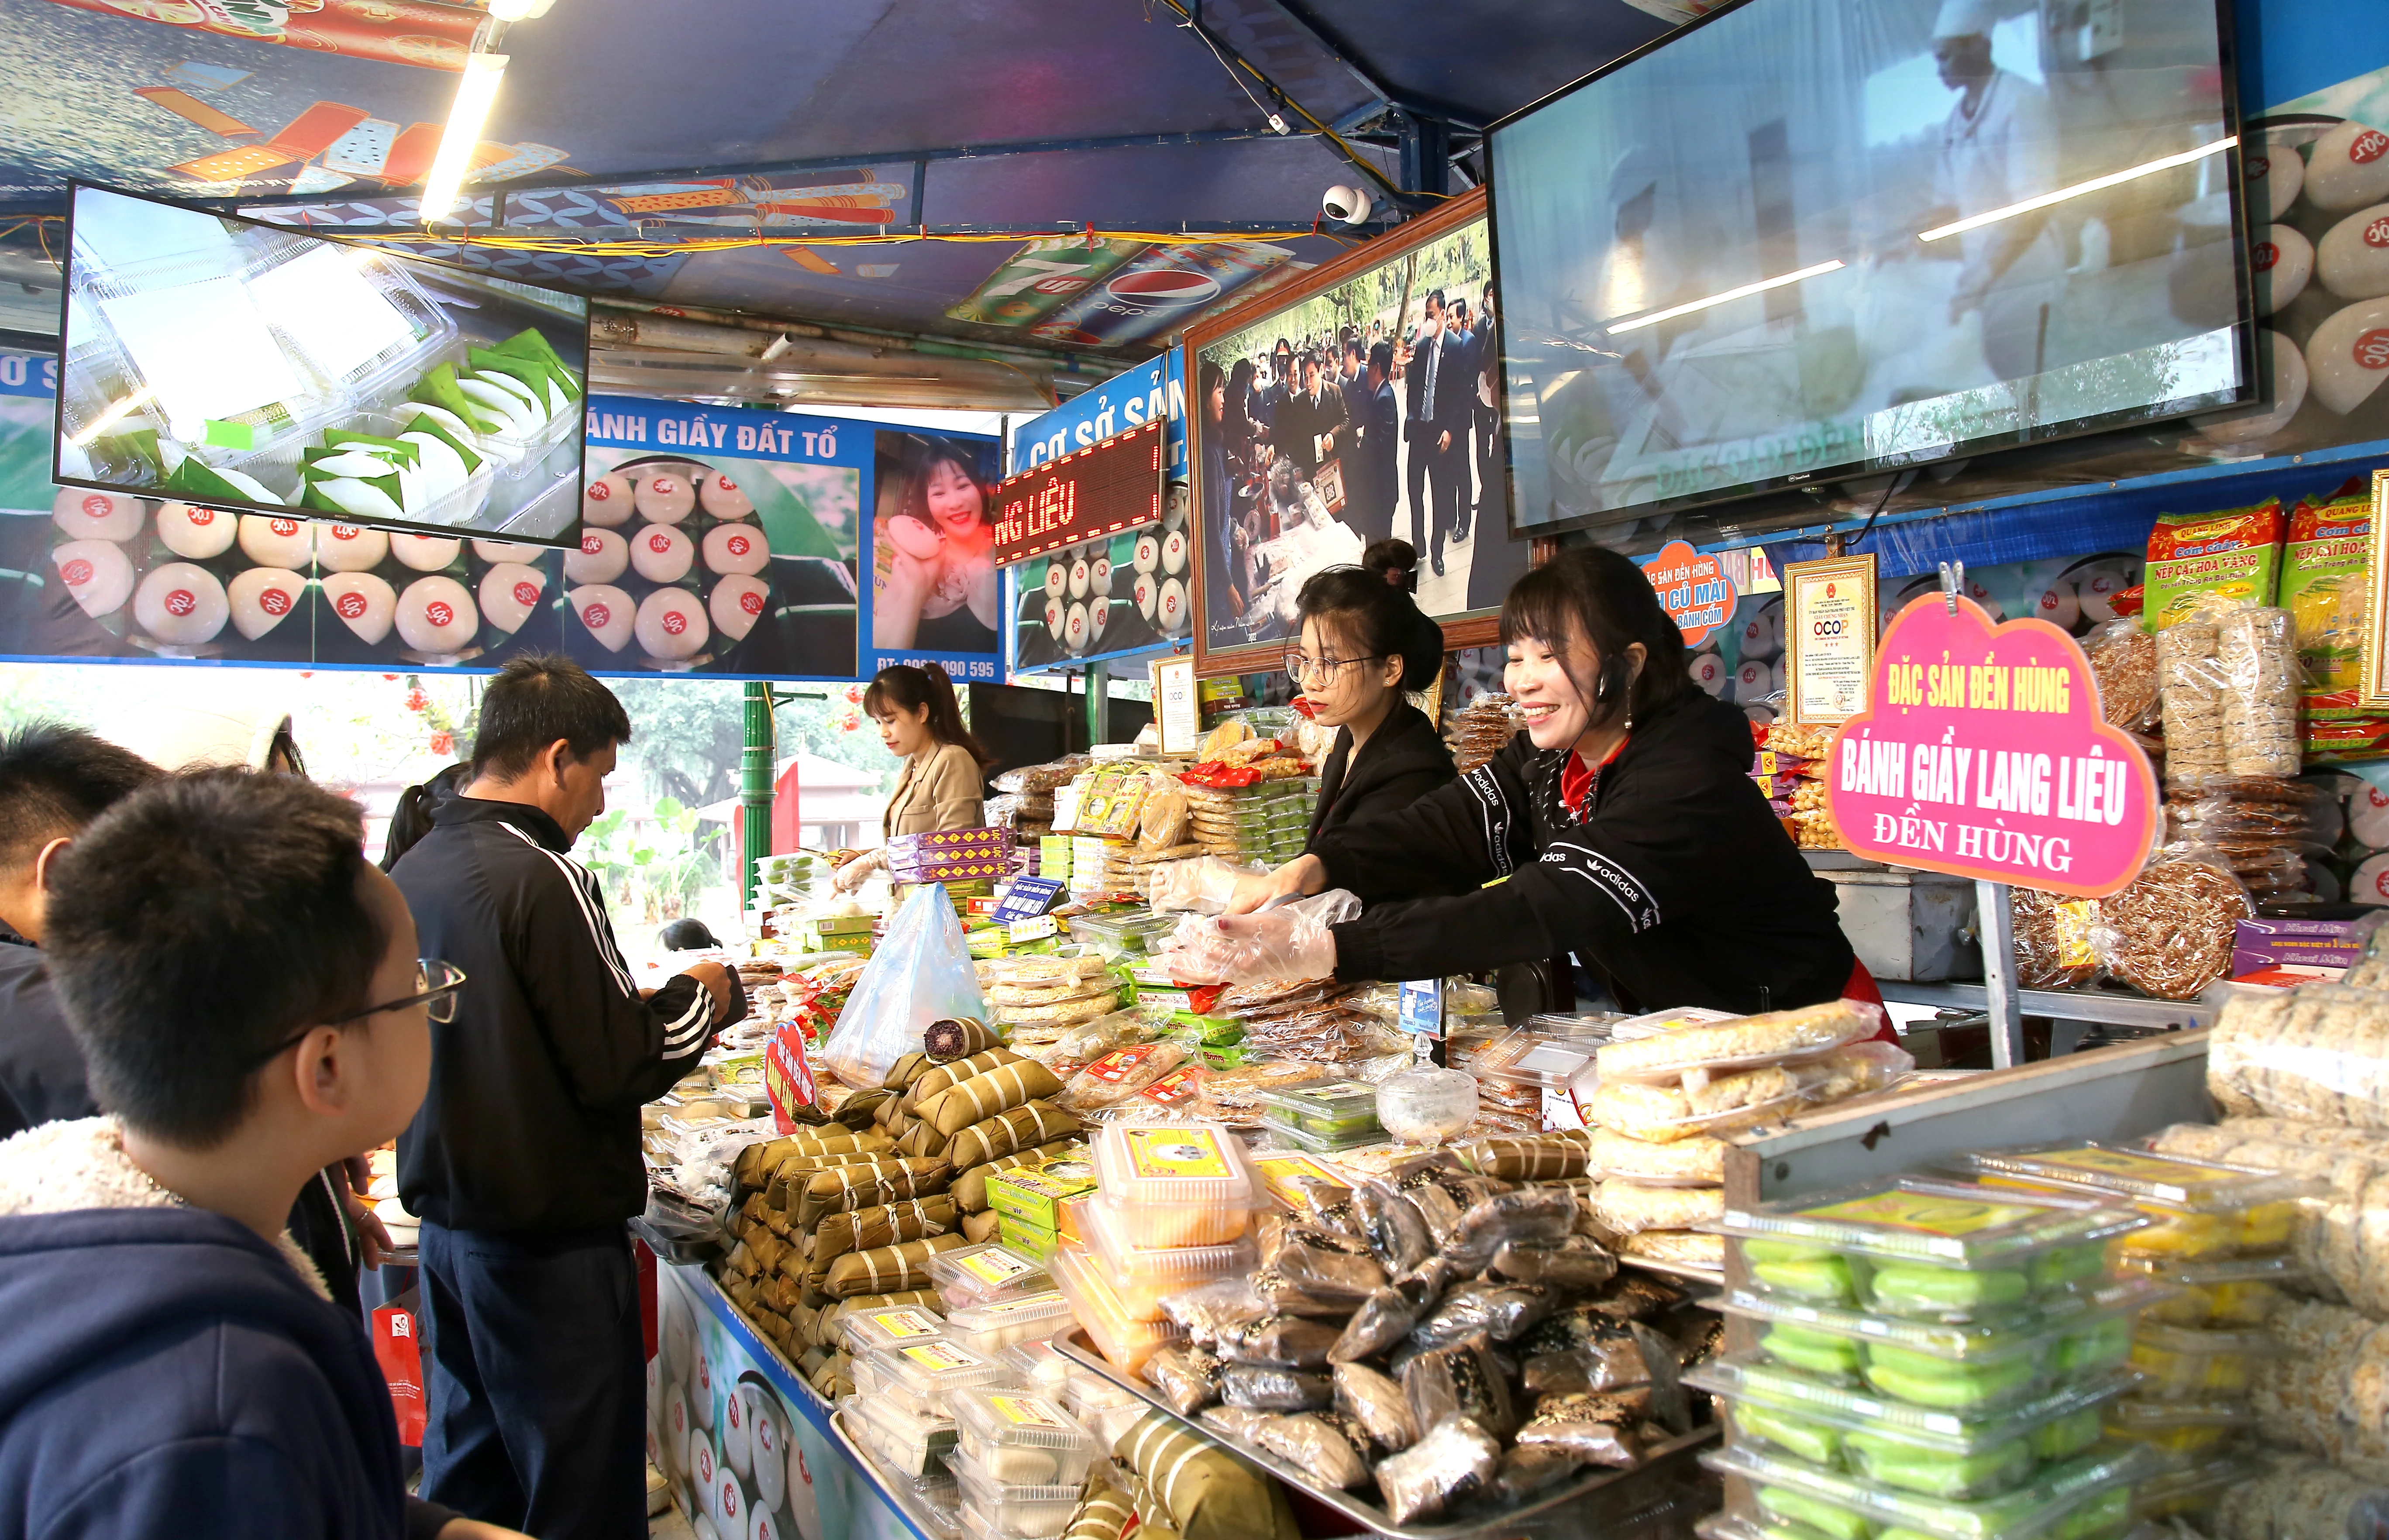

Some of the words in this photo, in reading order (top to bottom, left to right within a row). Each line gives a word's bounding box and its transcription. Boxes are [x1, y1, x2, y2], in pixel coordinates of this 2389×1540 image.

[984, 259, 1091, 297] 7
[1086, 300, 1168, 319] pepsi
[586, 406, 646, 442] ÁNH
[657, 413, 728, 449] GIẦY
[737, 419, 793, 457] ĐẤT
[802, 424, 838, 459] TỔ
[1074, 395, 1115, 447] SỞ
[1027, 475, 1075, 538] LIÊU
[2325, 506, 2359, 518] QUANG
[2181, 525, 2209, 538] QUANG
[2315, 526, 2350, 537] Cơm
[2352, 522, 2370, 534] ch
[2175, 546, 2204, 557] Cơm
[2293, 542, 2313, 561] NẾP
[2340, 542, 2367, 555] HOA
[1674, 561, 1691, 583] ĐỀN
[1692, 558, 1714, 577] HÙNG
[2155, 562, 2175, 581] NẾP
[2196, 558, 2220, 574] HOA
[1668, 580, 1692, 609] CỦ
[1696, 577, 1727, 603] MÀI
[1677, 610, 1700, 629] BÁNH
[1702, 605, 1721, 624] CỐM
[1814, 619, 1849, 636] OCOP
[969, 661, 995, 677] 595
[1888, 656, 1923, 715] ĐẶC
[1927, 650, 1965, 708] SẢN
[1969, 648, 2010, 711] ĐỀN
[2013, 656, 2070, 714] HÙNG
[1169, 691, 1187, 701] OCOP
[1841, 728, 1907, 799] BÁNH
[1911, 725, 1972, 806] GIẦY
[1976, 748, 2052, 817] LANG
[2057, 743, 2127, 826] LIÊU
[1472, 772, 1499, 806] adidas
[991, 829, 1002, 841] LỘC
[1873, 801, 1947, 853] ĐỀN
[1956, 818, 2073, 873] HÙNG
[992, 846, 1003, 859] LỘC
[1494, 833, 1508, 876] adidas
[996, 862, 1007, 874] LỘC
[1600, 867, 1639, 902] adidas
[2282, 952, 2319, 962] Khoai
[767, 1057, 782, 1101] BÁNH
